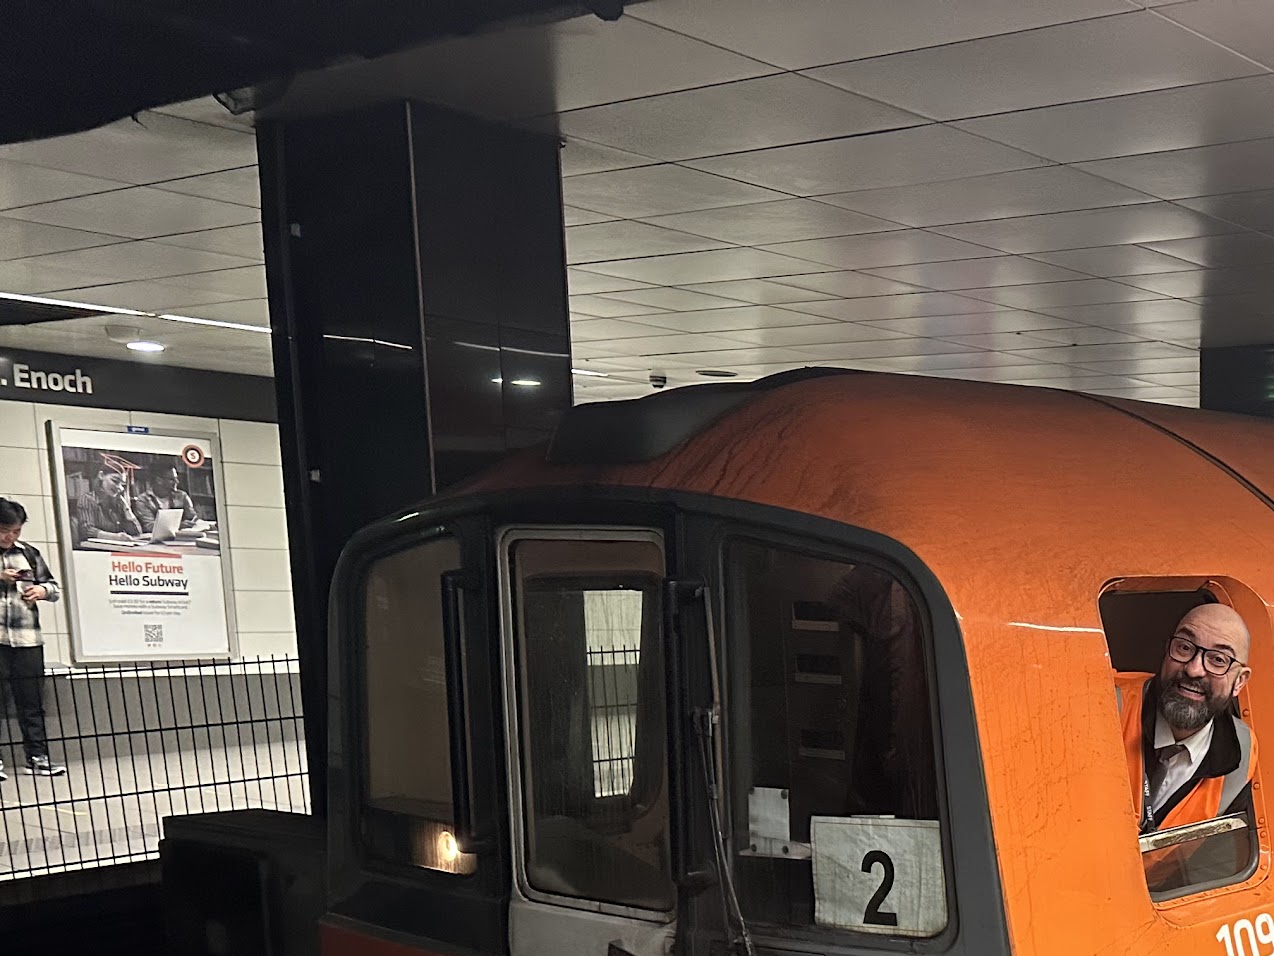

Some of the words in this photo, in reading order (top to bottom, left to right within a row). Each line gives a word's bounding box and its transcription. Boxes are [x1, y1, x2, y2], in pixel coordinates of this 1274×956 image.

[13, 363, 93, 394] Enoch
[112, 561, 143, 573] Hello
[145, 562, 183, 574] Future
[109, 575, 140, 586] Hello
[142, 576, 188, 590] Subway
[861, 850, 898, 926] 2
